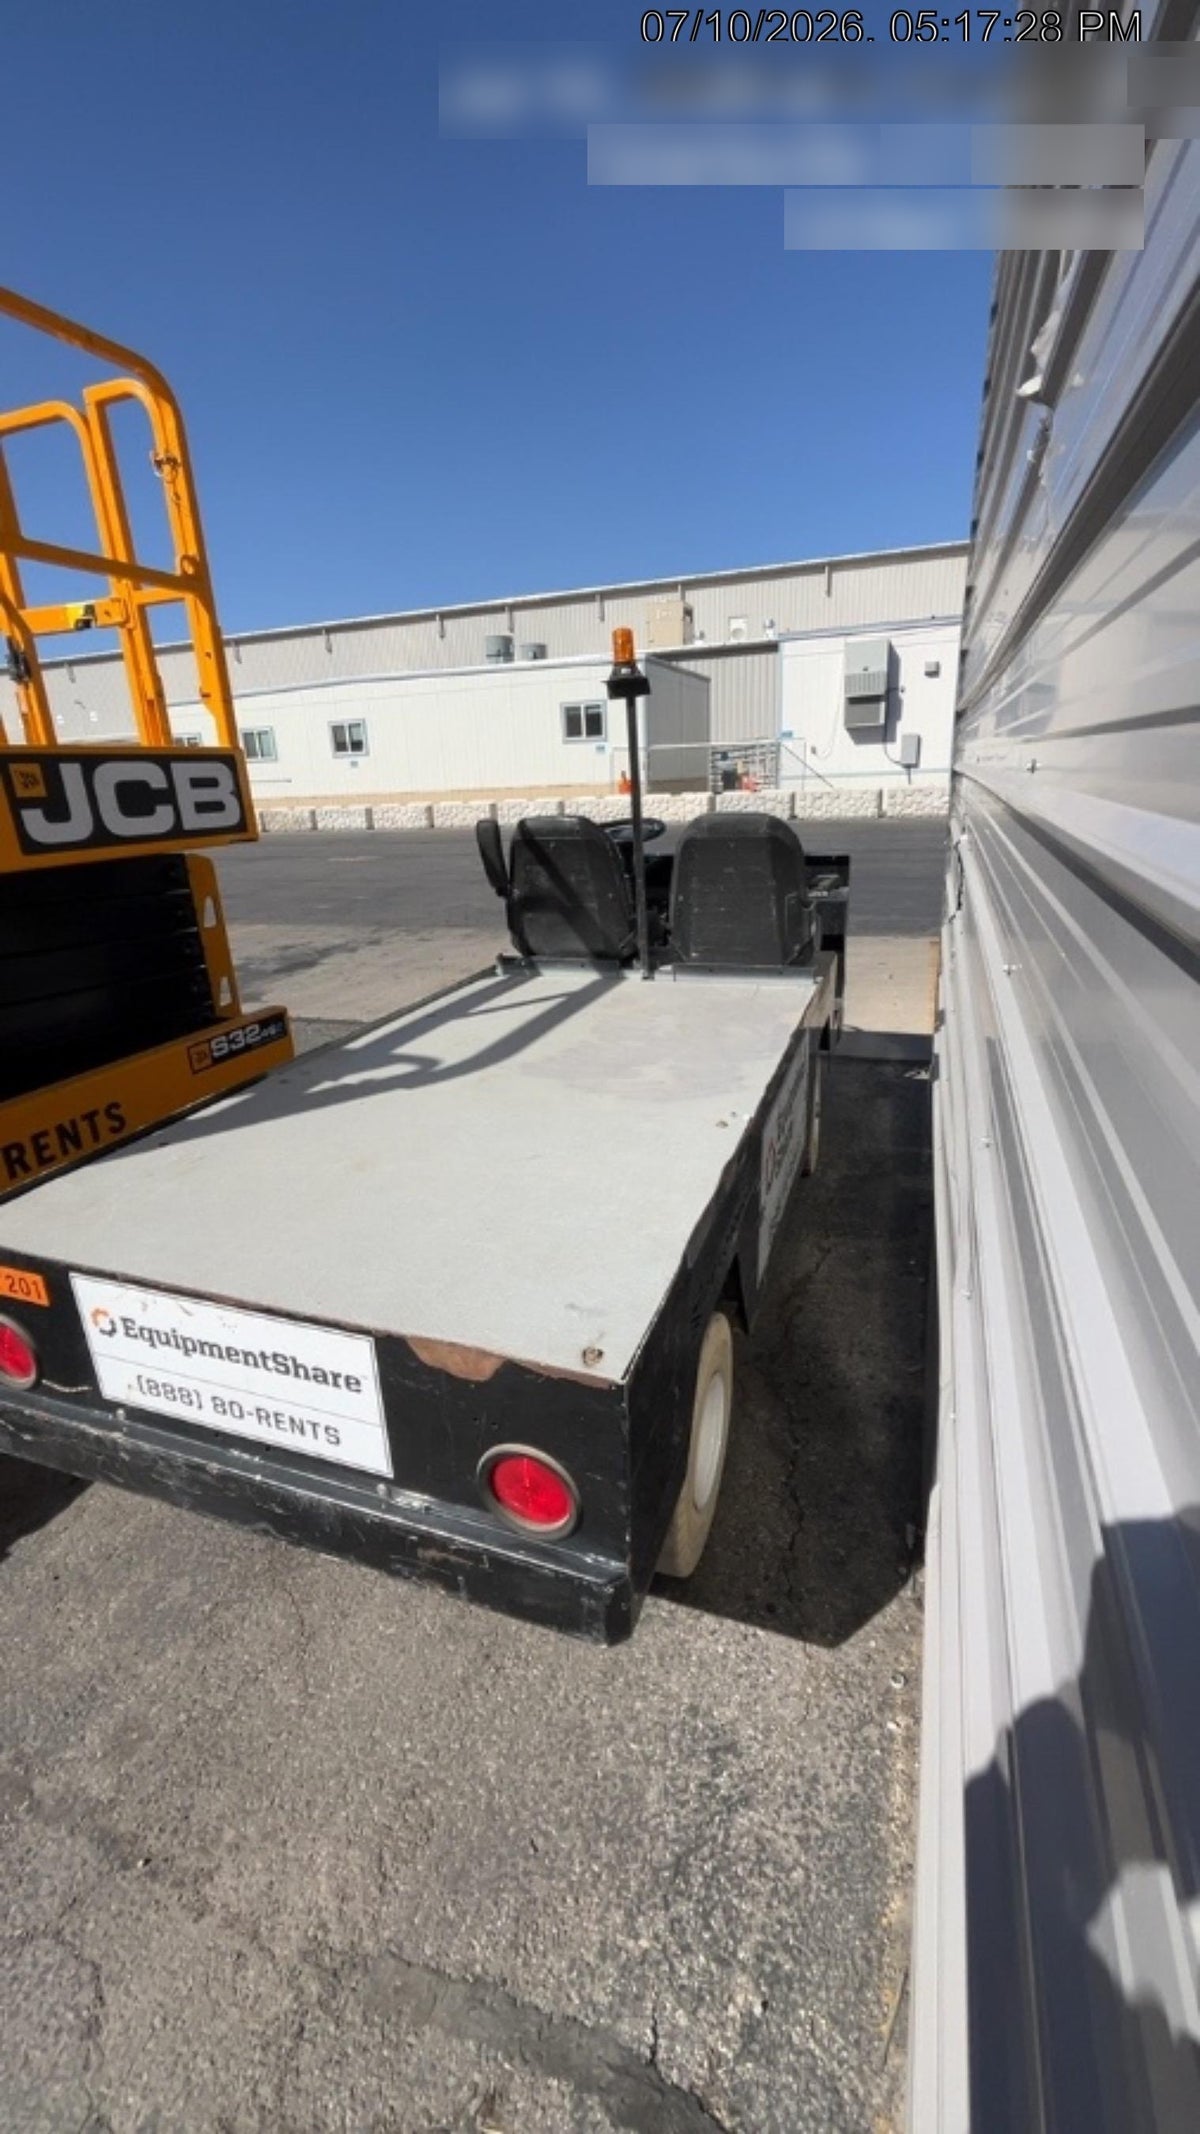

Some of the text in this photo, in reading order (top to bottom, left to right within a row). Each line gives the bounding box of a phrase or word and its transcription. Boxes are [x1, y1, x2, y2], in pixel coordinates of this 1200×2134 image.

[20, 761, 241, 845] JCB
[1, 1102, 126, 1180] RENTS
[4, 1275, 41, 1300] 201
[120, 1316, 362, 1394] EquipmentShare
[136, 1375, 341, 1446] (888) 80-RENTS
